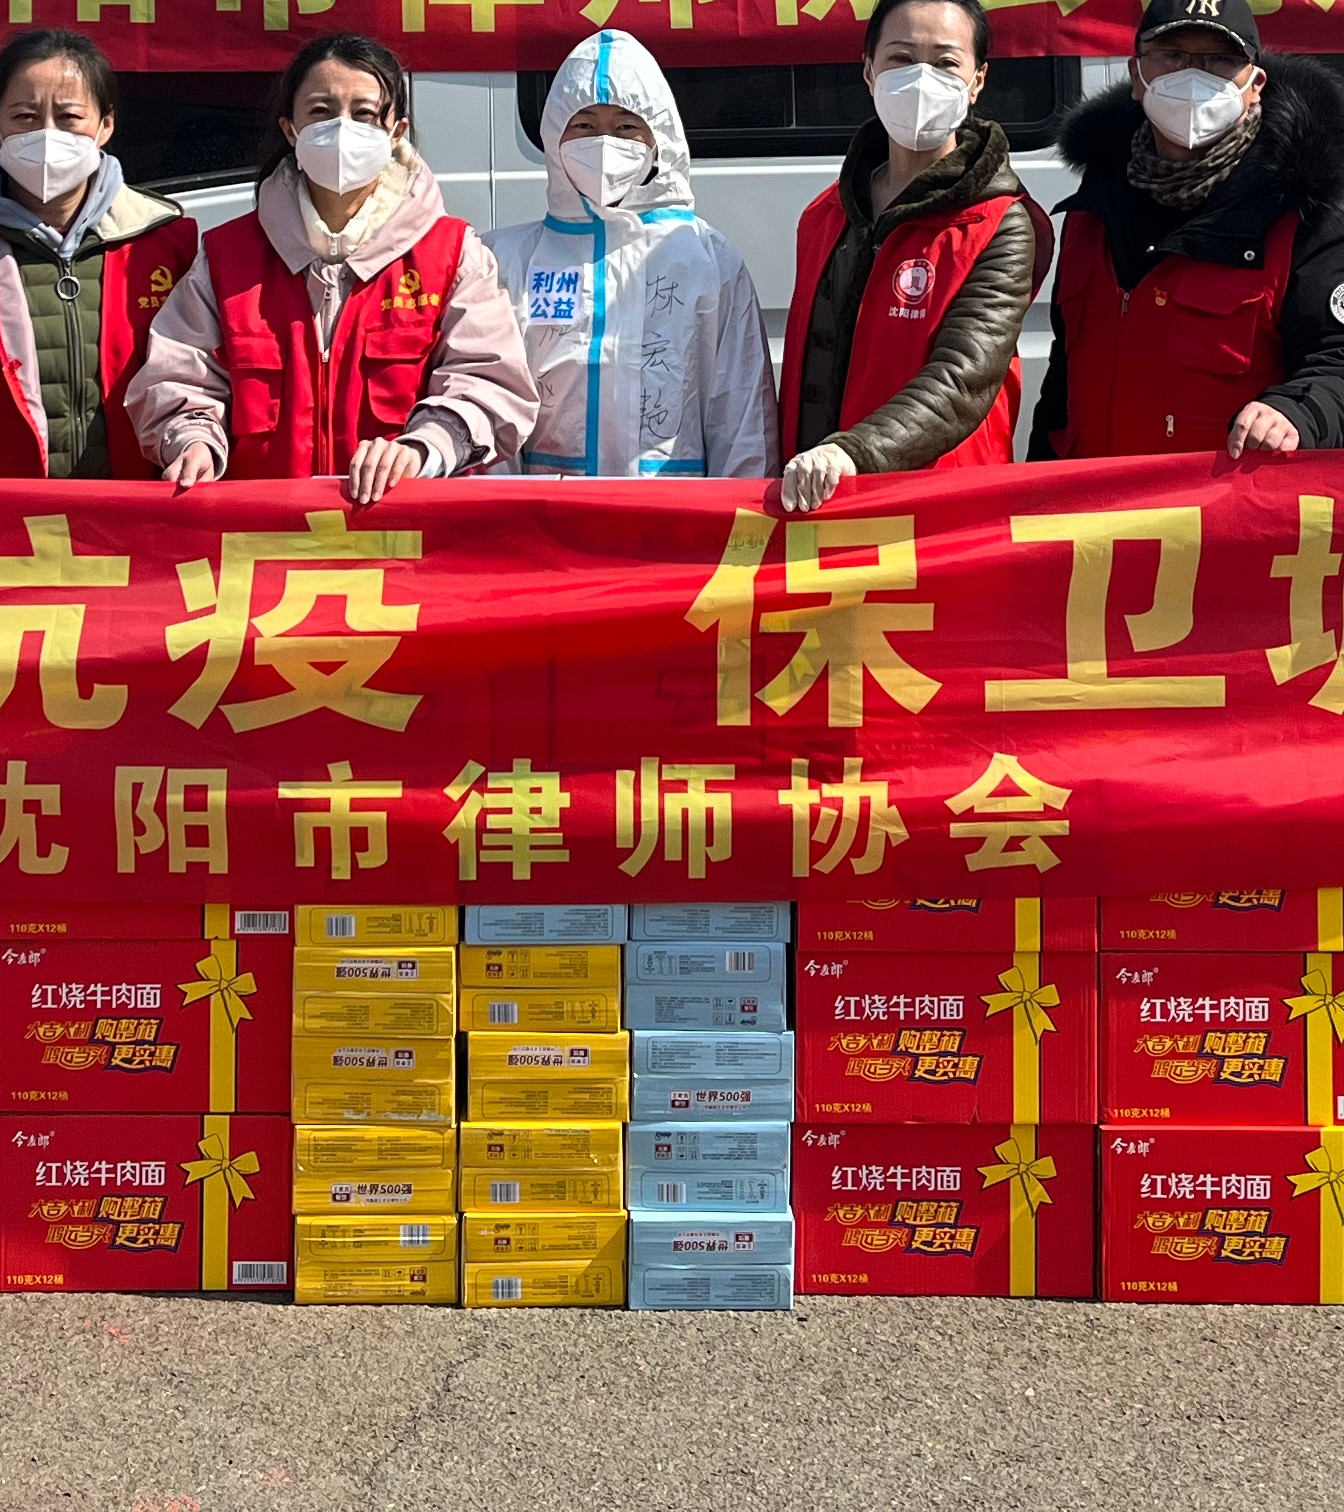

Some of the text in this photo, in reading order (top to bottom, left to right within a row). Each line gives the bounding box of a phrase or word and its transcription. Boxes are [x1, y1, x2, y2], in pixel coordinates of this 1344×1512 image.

[532, 271, 579, 294] 利州
[530, 297, 575, 319] 公益
[31, 982, 162, 1009] 红烧牛肉面
[834, 994, 965, 1021] 红烧牛肉面
[1139, 995, 1270, 1023] 红烧牛肉面
[35, 1160, 166, 1187] 红烧牛肉面
[831, 1164, 962, 1192] 红烧牛肉面
[1140, 1172, 1272, 1200] 红烧牛肉面
